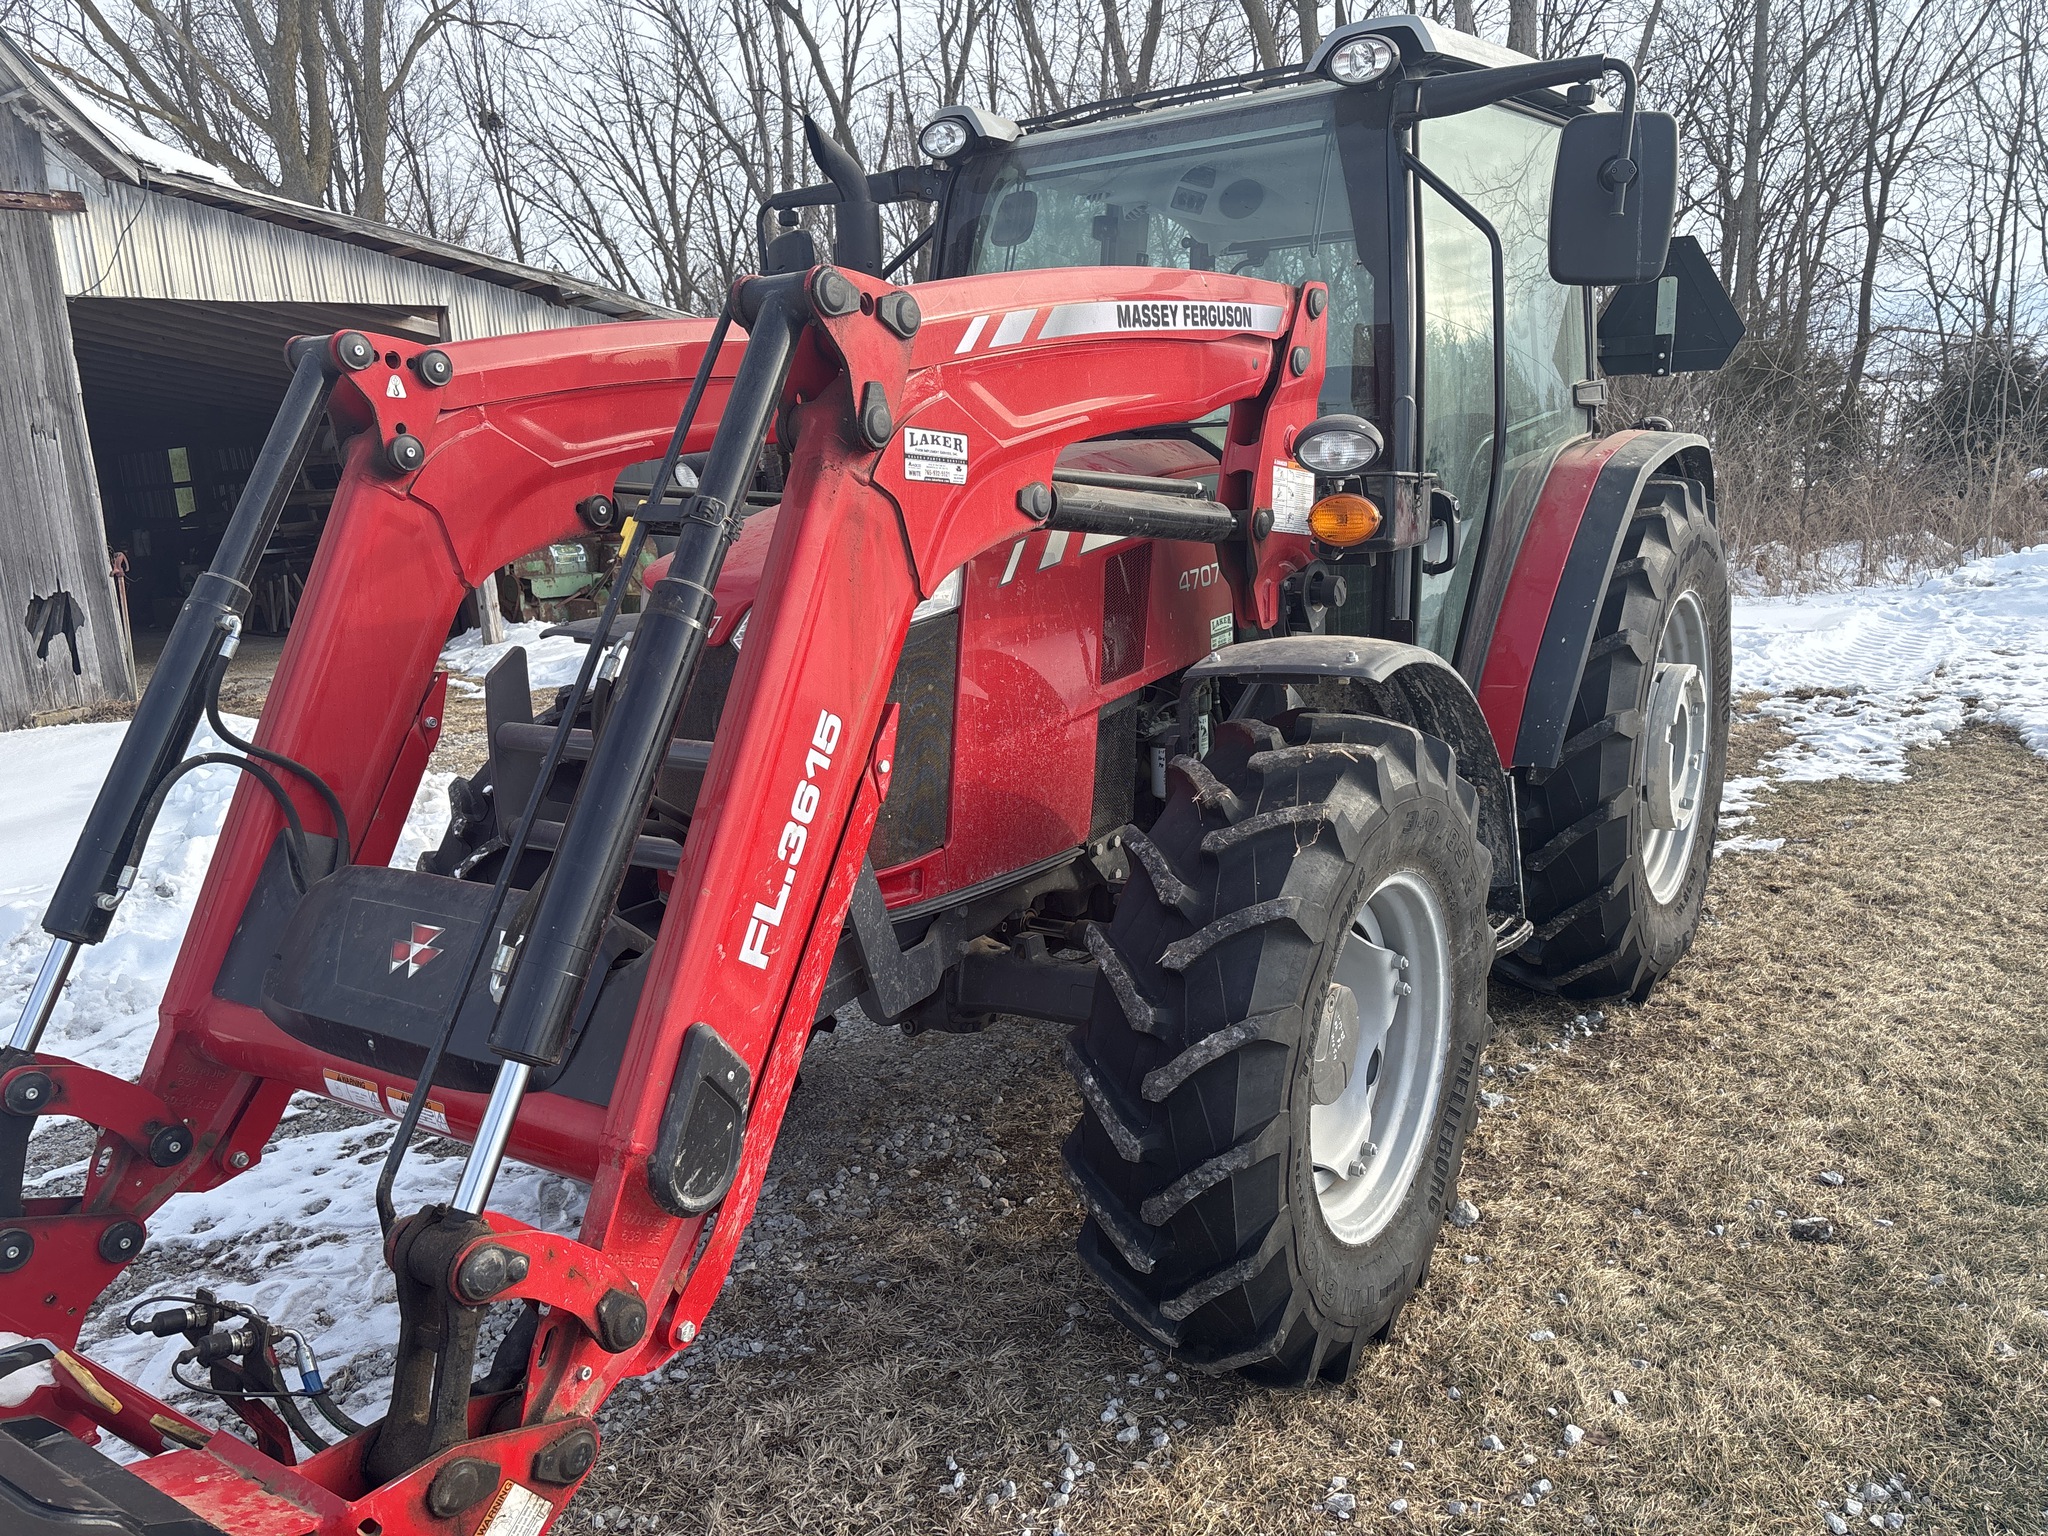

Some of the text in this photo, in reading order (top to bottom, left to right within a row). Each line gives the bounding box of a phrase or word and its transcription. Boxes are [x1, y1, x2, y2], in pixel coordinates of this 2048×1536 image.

[1116, 304, 1253, 329] MASSEY FERGUSON
[909, 432, 964, 453] LAKER
[1179, 562, 1219, 592] 4707
[1211, 615, 1232, 631] LAKER
[738, 708, 843, 970] FL.3615
[341, 1075, 366, 1089] WARNING
[1428, 1041, 1480, 1217] TRELLEBORG
[477, 1482, 514, 1535] WARNING
